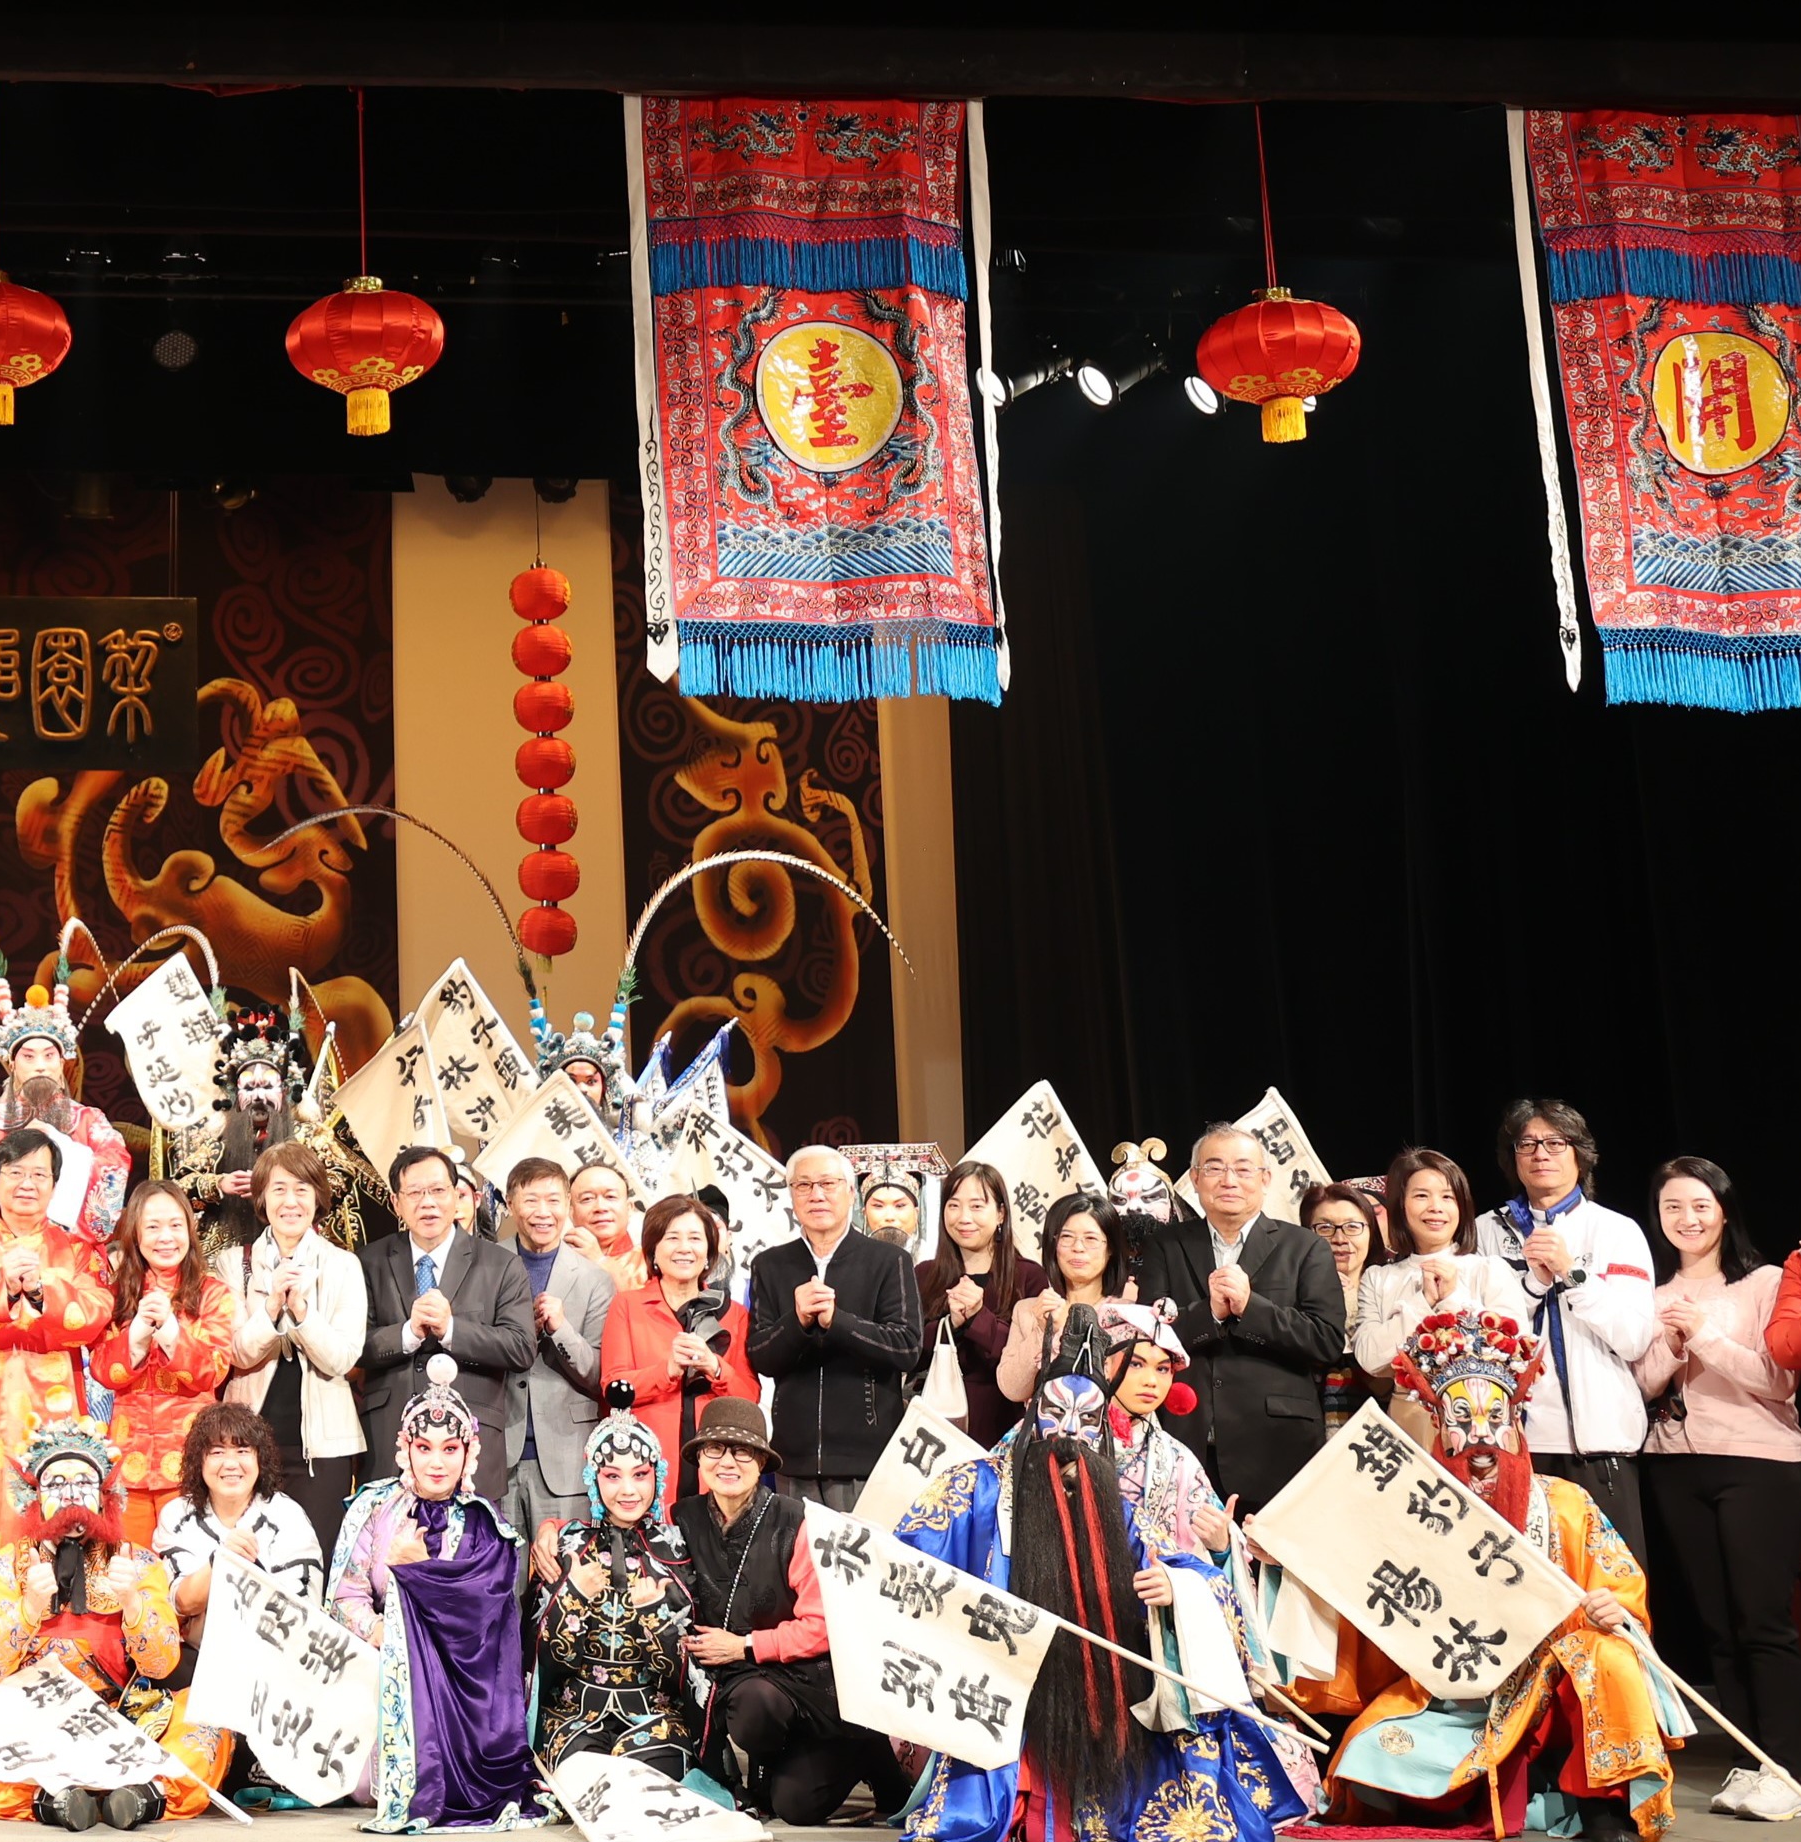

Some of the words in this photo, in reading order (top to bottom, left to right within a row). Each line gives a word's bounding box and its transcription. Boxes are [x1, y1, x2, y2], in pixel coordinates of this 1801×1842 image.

[1672, 351, 1757, 451] 開
[438, 978, 530, 1091] 豹子頭
[1347, 1421, 1526, 1587] 錦豹子
[1366, 1559, 1509, 1684] 楊林
